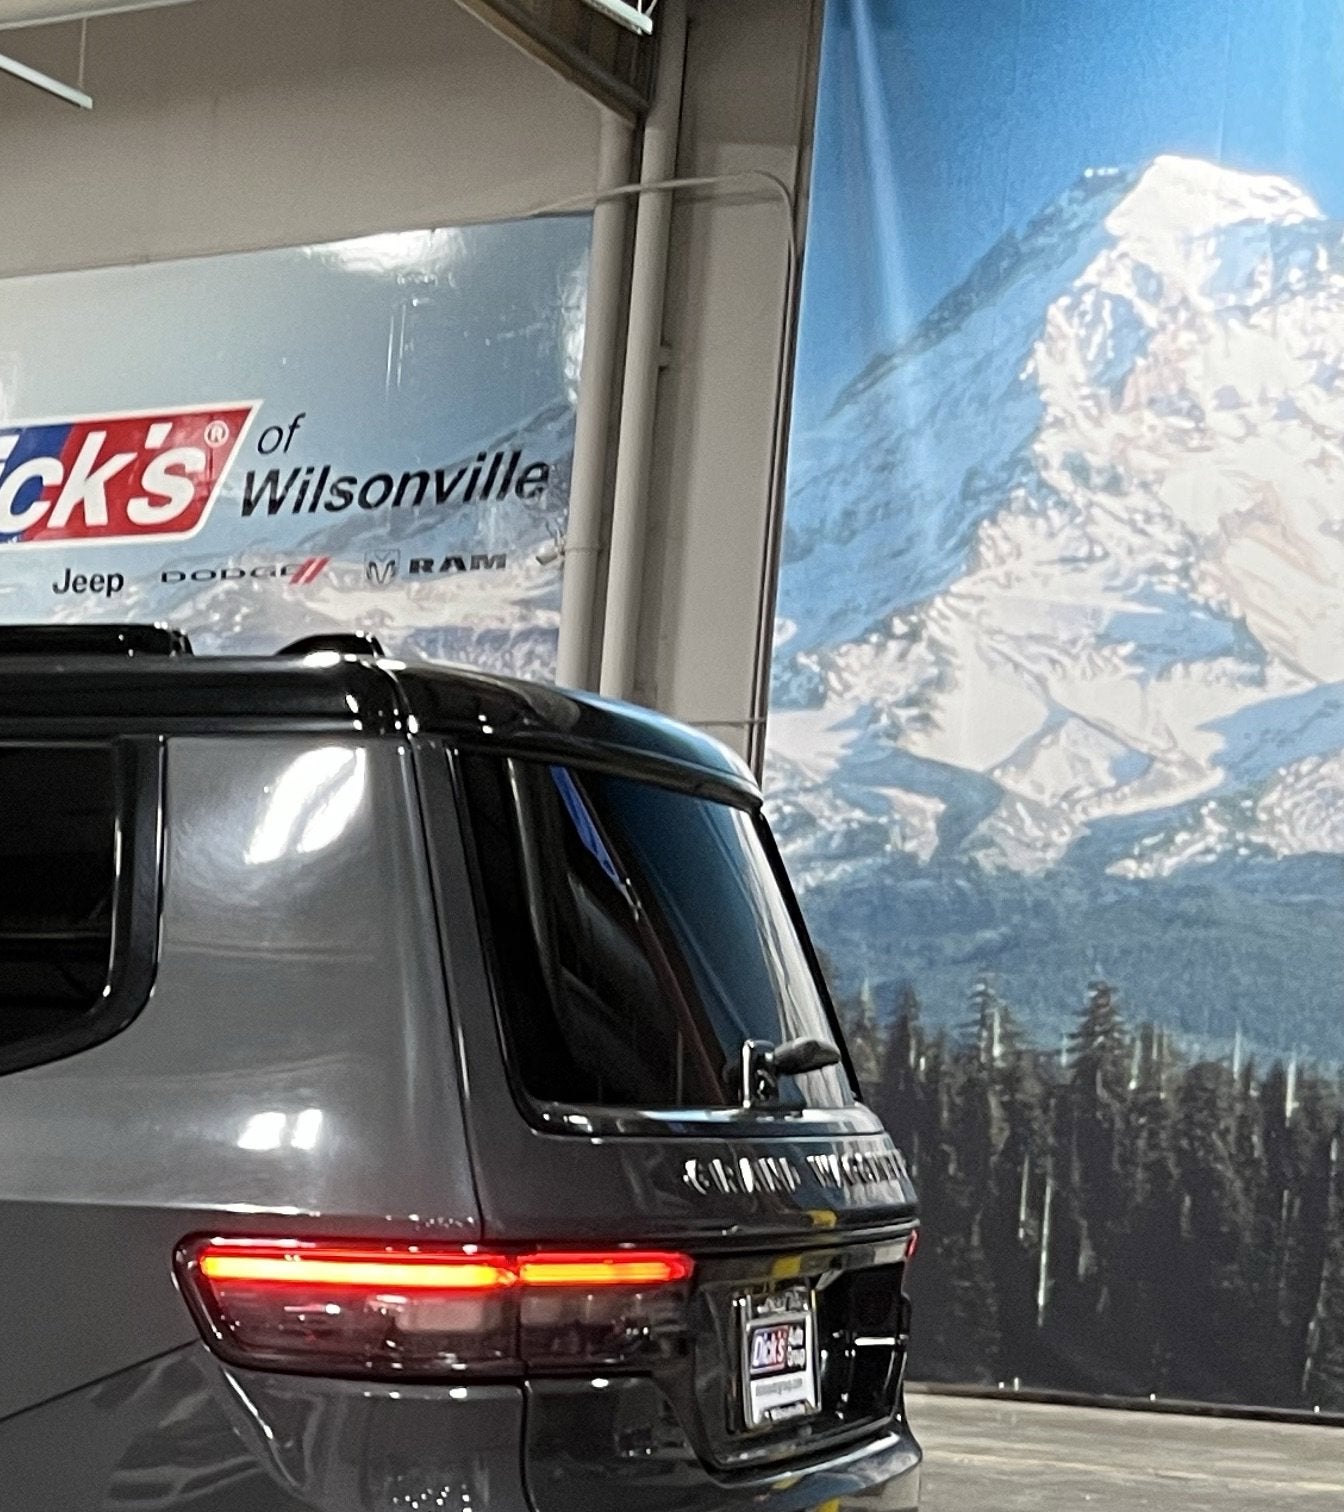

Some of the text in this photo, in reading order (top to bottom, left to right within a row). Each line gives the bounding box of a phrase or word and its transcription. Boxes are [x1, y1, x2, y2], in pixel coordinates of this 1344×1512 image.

[257, 412, 306, 455] of
[241, 449, 550, 518] Wilsonville
[52, 567, 125, 598] Jeep
[409, 553, 507, 574] RAM
